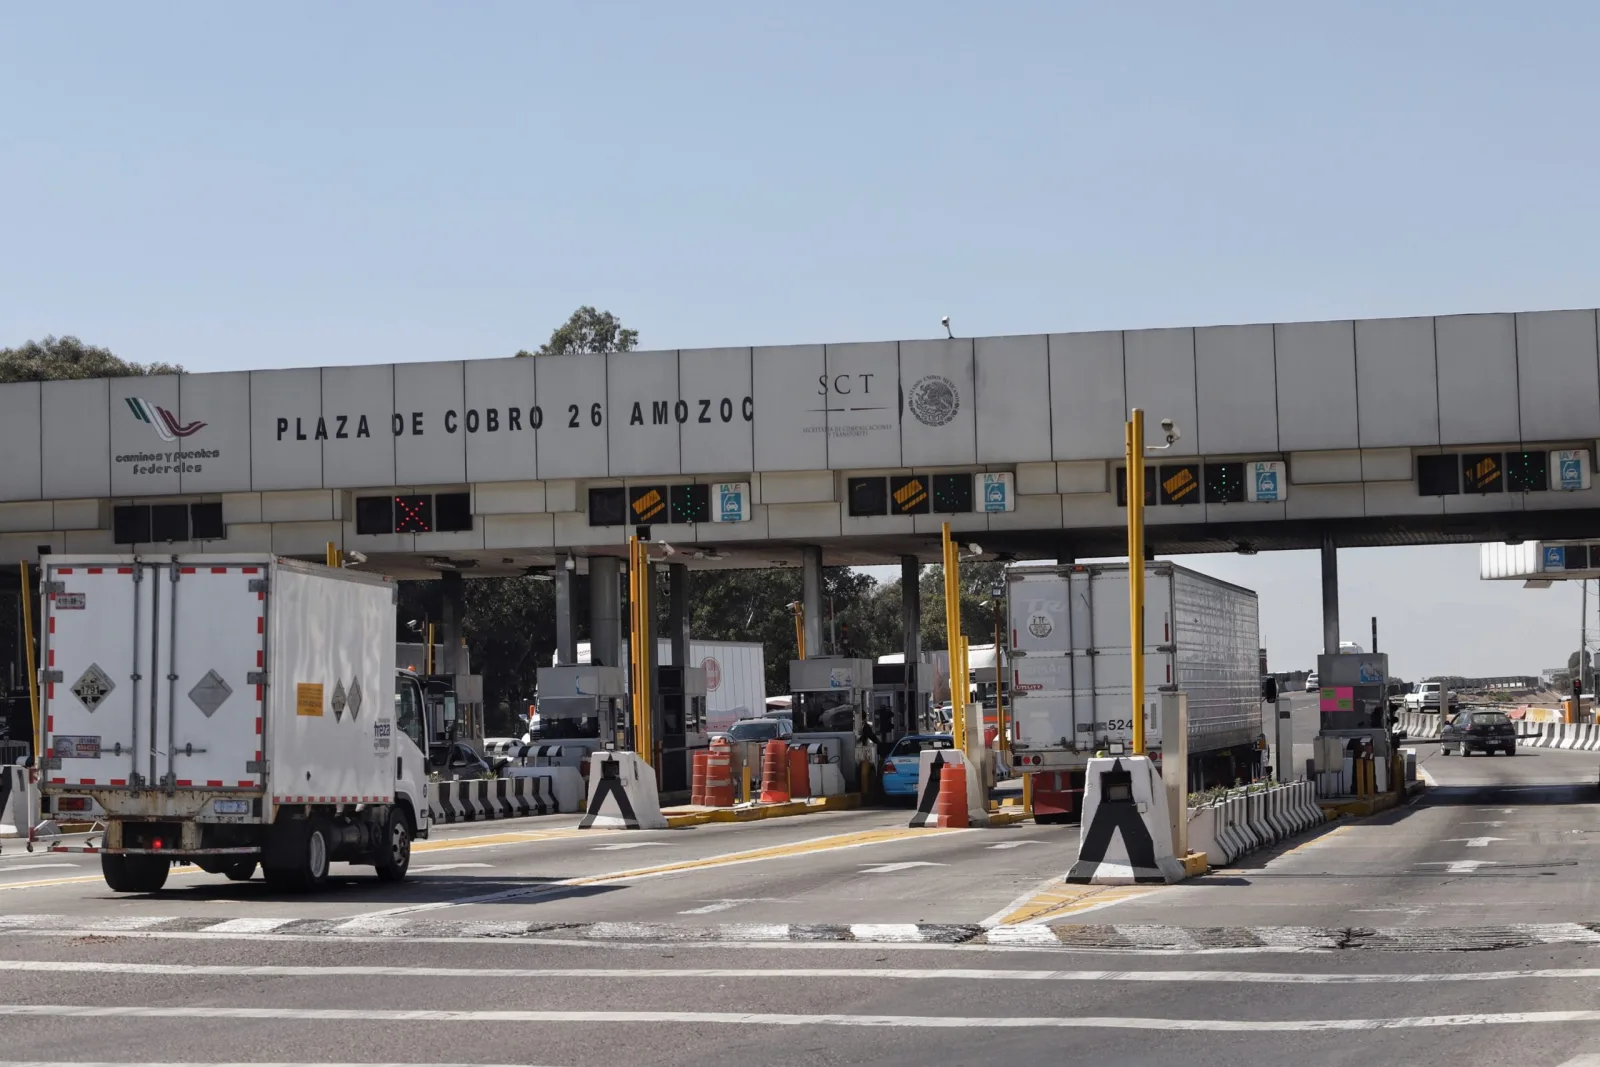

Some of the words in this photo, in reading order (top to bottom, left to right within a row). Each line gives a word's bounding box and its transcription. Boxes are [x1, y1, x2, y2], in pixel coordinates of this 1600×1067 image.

[817, 374, 874, 396] SCT
[277, 414, 371, 441] PLAZA
[391, 411, 425, 437] DE
[444, 405, 544, 434] COBRO
[568, 402, 603, 429] 26
[629, 396, 754, 427] AMOZOC
[115, 452, 163, 463] caminos
[173, 448, 220, 462] puentes
[133, 461, 203, 475] federales
